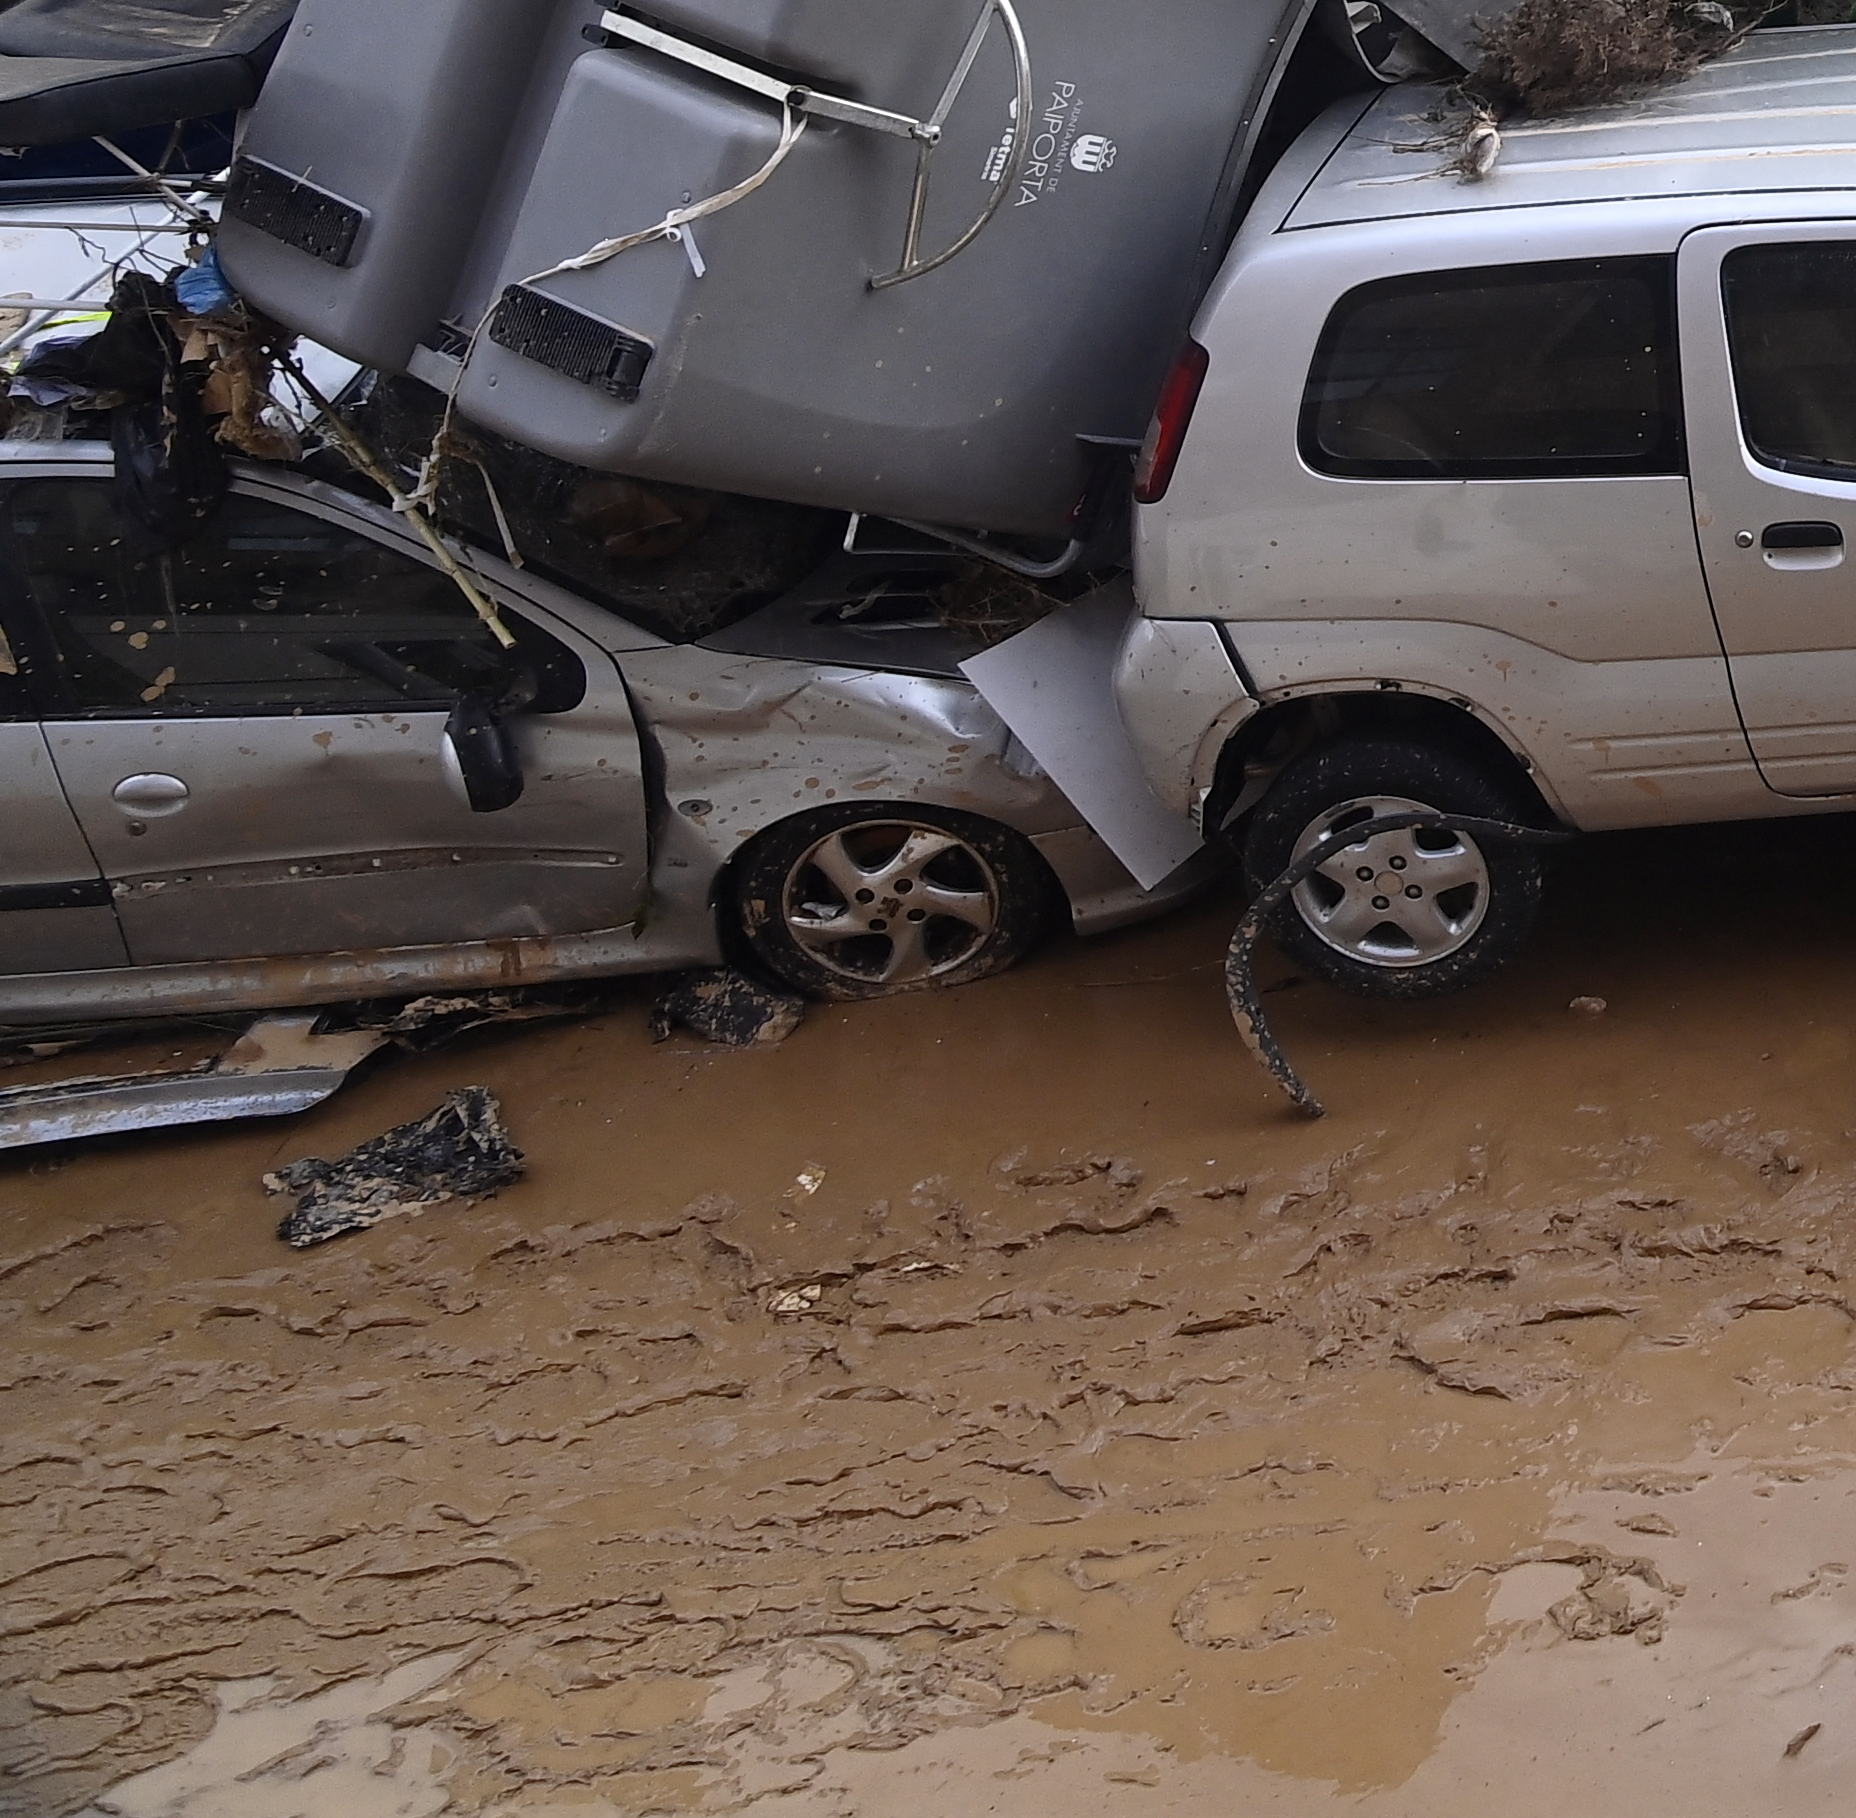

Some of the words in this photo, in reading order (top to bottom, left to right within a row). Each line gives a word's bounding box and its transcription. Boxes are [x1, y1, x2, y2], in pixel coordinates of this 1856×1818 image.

[1013, 80, 1076, 207] PAIPORTA
[1053, 98, 1085, 174] AJUNTAMENT
[1046, 177, 1059, 193] DE
